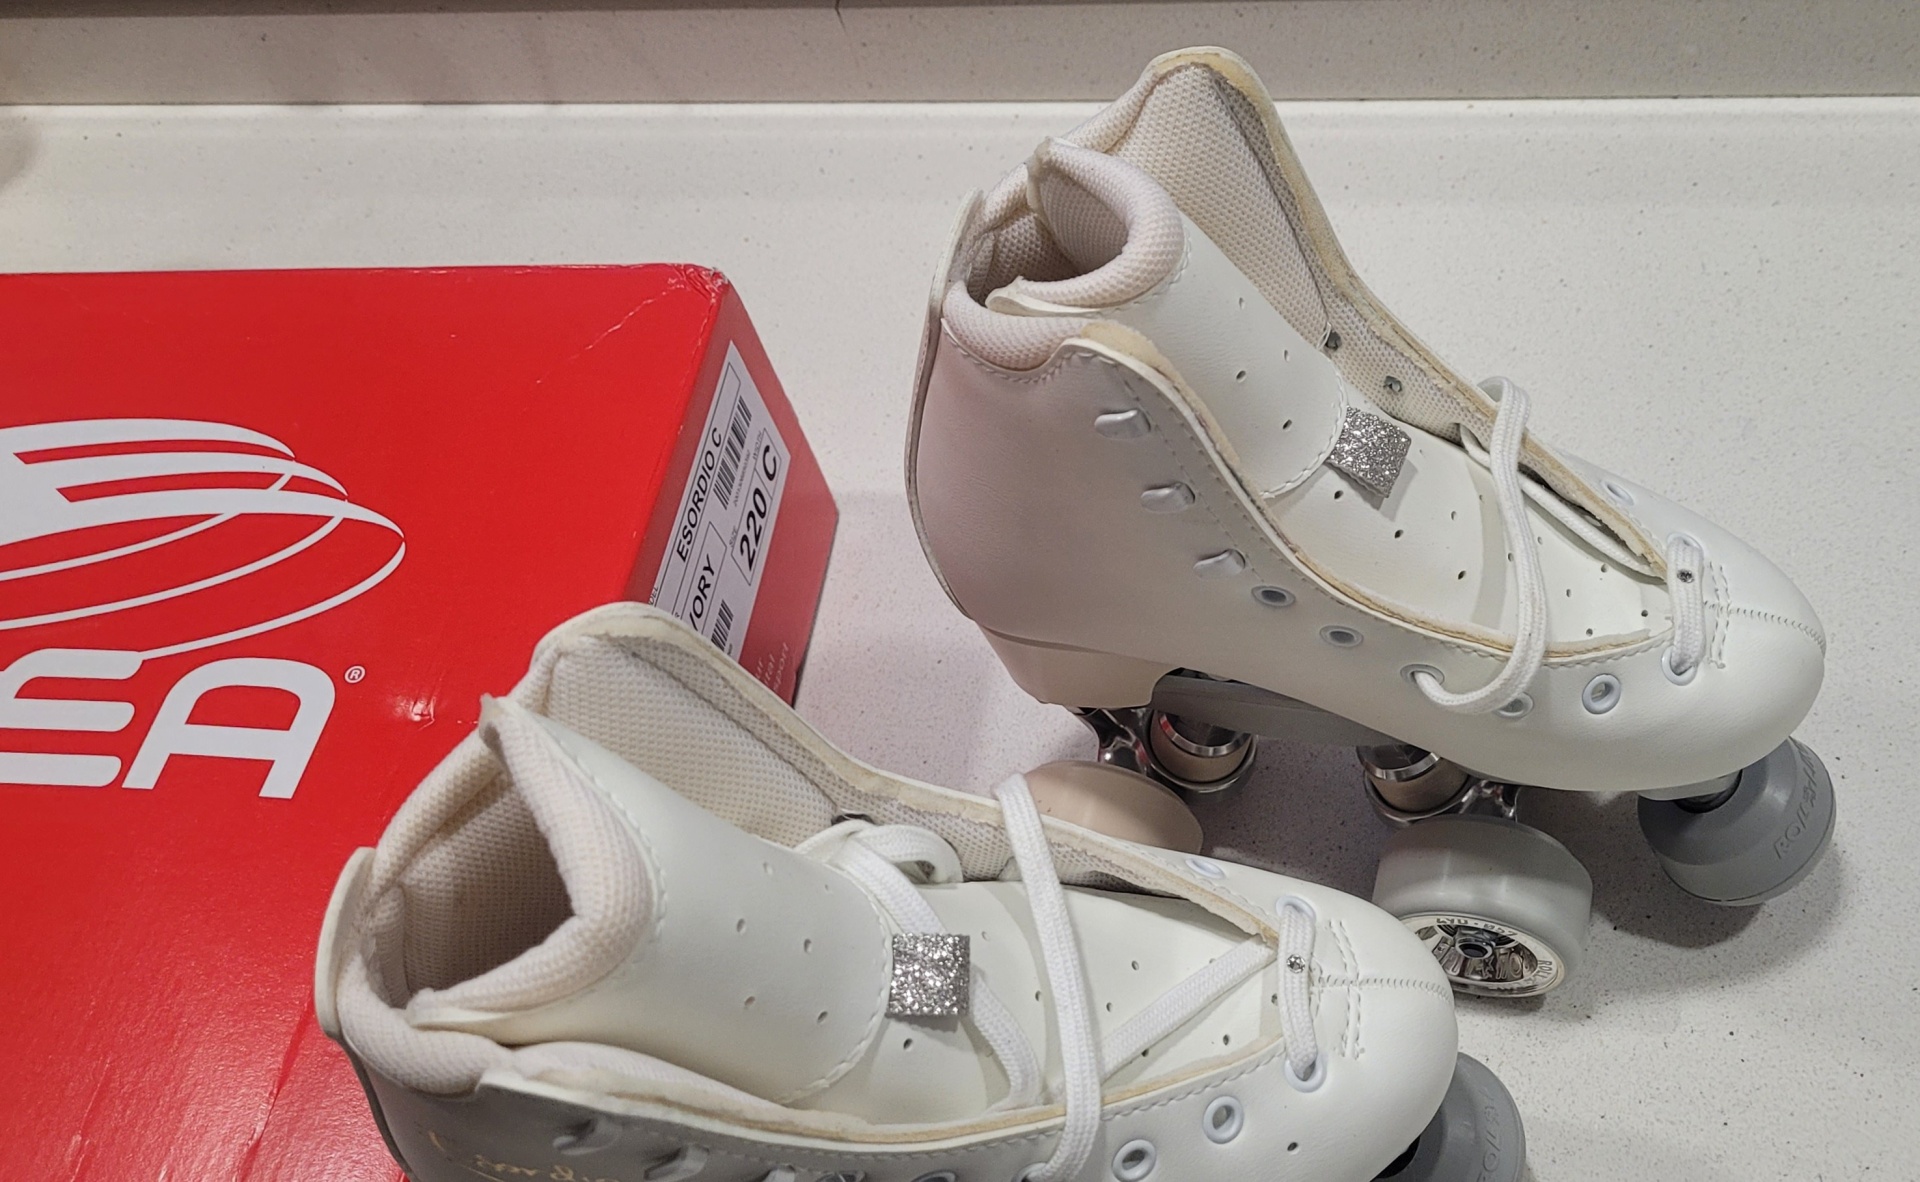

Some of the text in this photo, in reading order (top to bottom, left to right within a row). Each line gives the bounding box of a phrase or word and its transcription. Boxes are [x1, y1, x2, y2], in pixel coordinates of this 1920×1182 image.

[676, 427, 722, 562] ESORDIO C
[740, 487, 767, 571] 220
[762, 445, 777, 481] C
